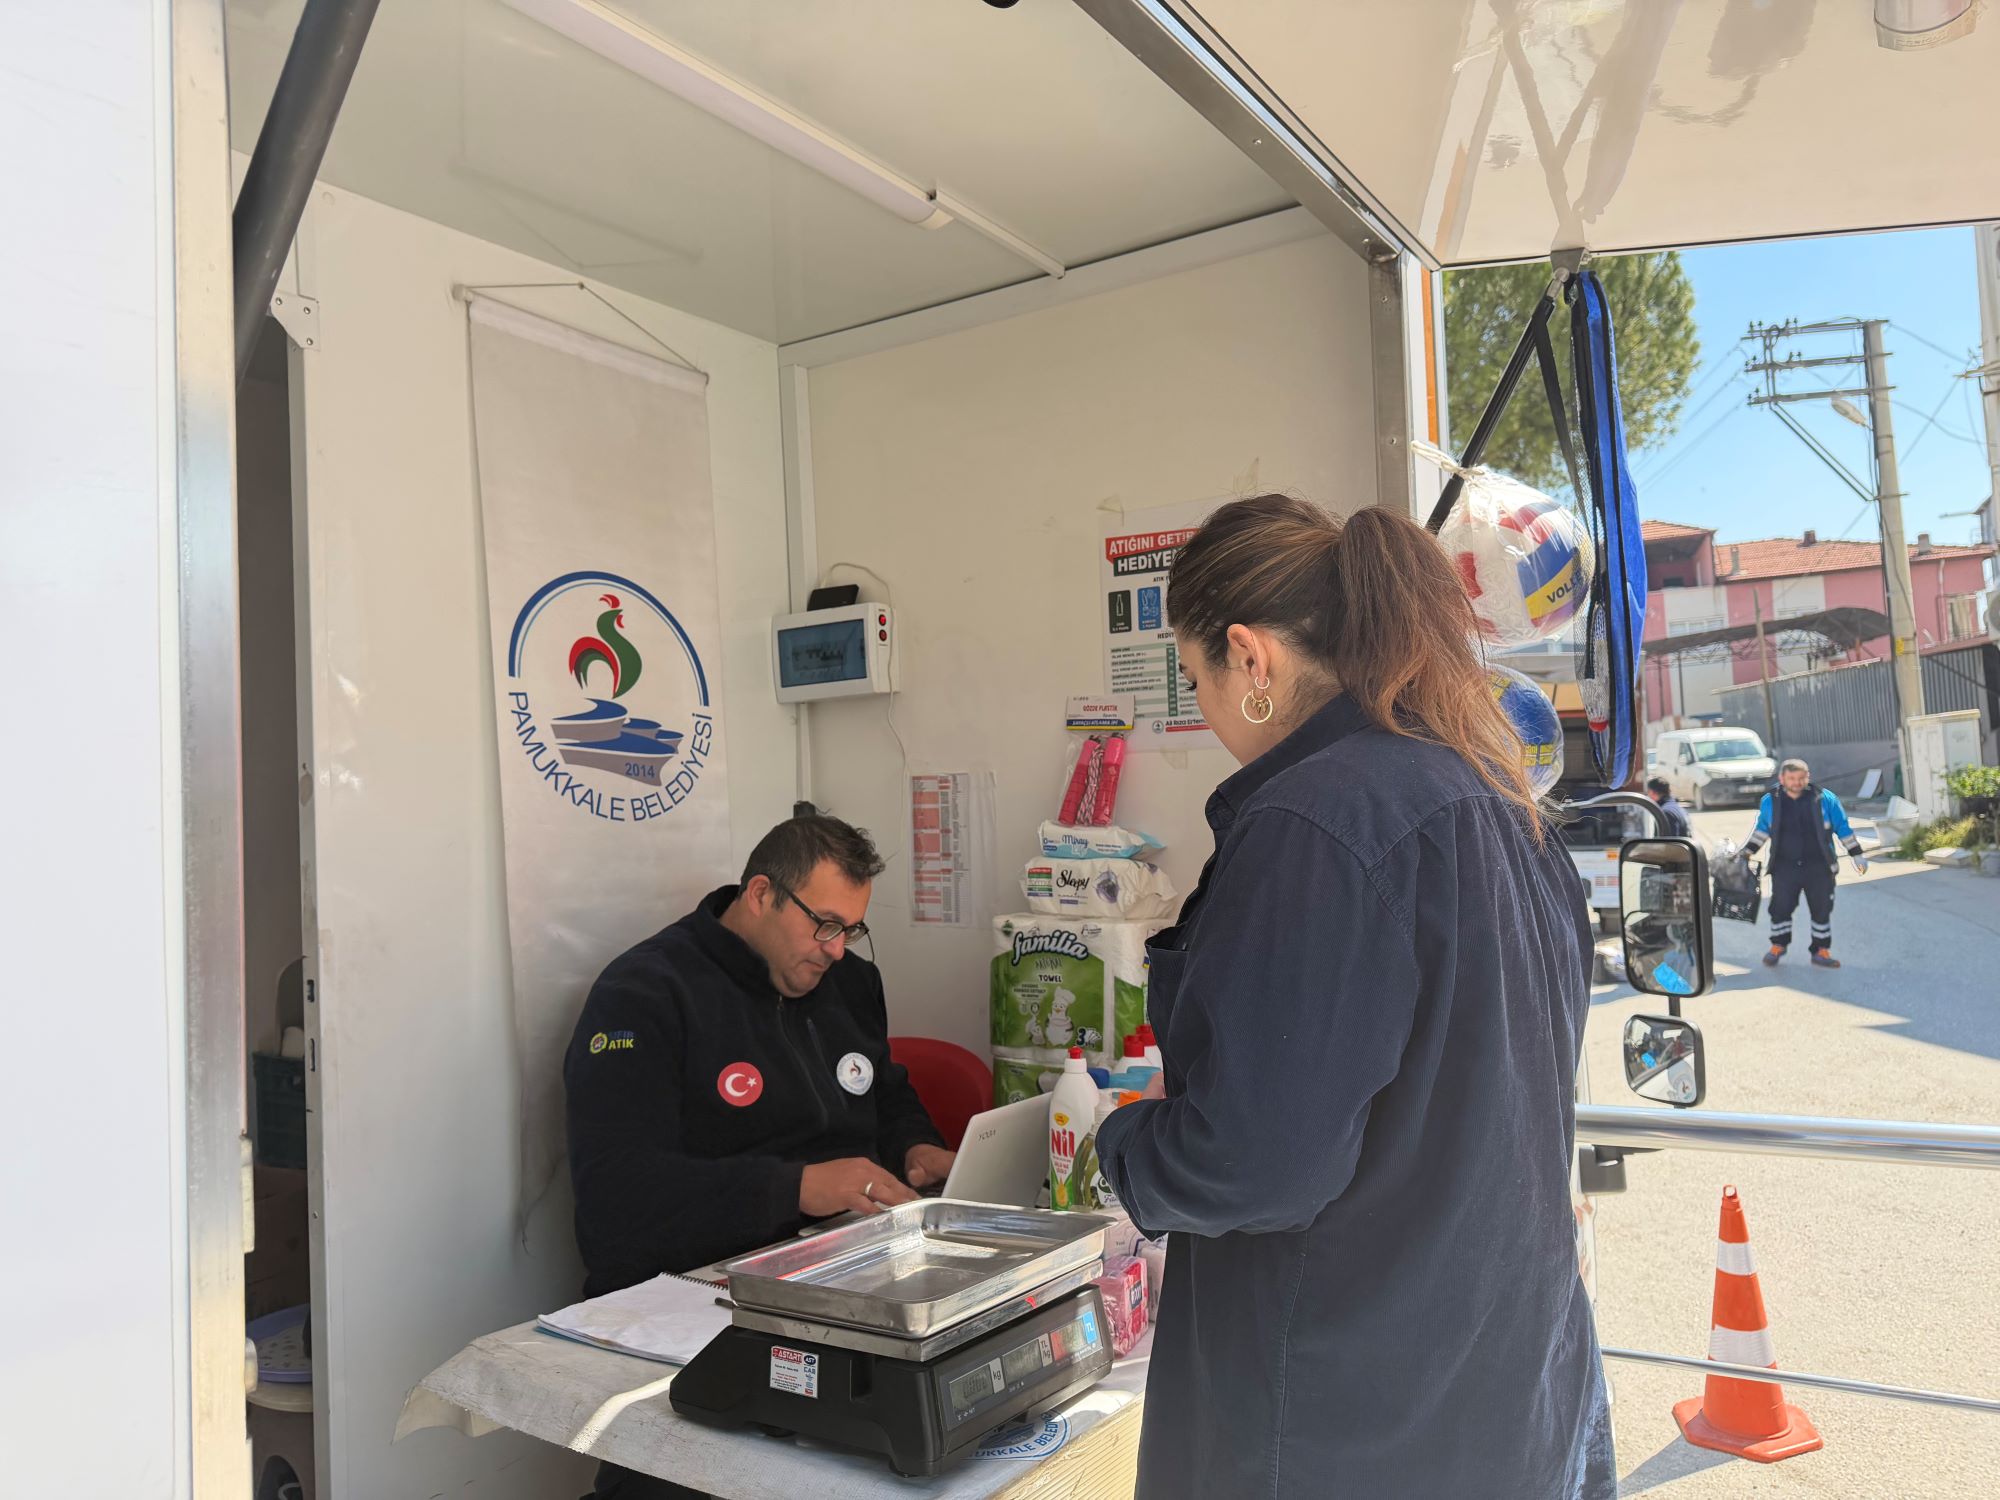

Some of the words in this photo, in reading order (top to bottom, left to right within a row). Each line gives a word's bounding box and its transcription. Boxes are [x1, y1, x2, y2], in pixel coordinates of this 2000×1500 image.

[508, 691, 626, 822] PAMUKKALE
[630, 712, 713, 822] BELEDİYESİ
[624, 761, 656, 778] 2014
[1056, 869, 1090, 895] Sleepy
[1012, 930, 1088, 966] familia
[1038, 974, 1062, 983] TOWEL
[608, 1038, 634, 1050] ATIK
[1076, 1027, 1087, 1045] 3
[1051, 1127, 1075, 1158] Nil
[992, 1369, 1002, 1381] kg
